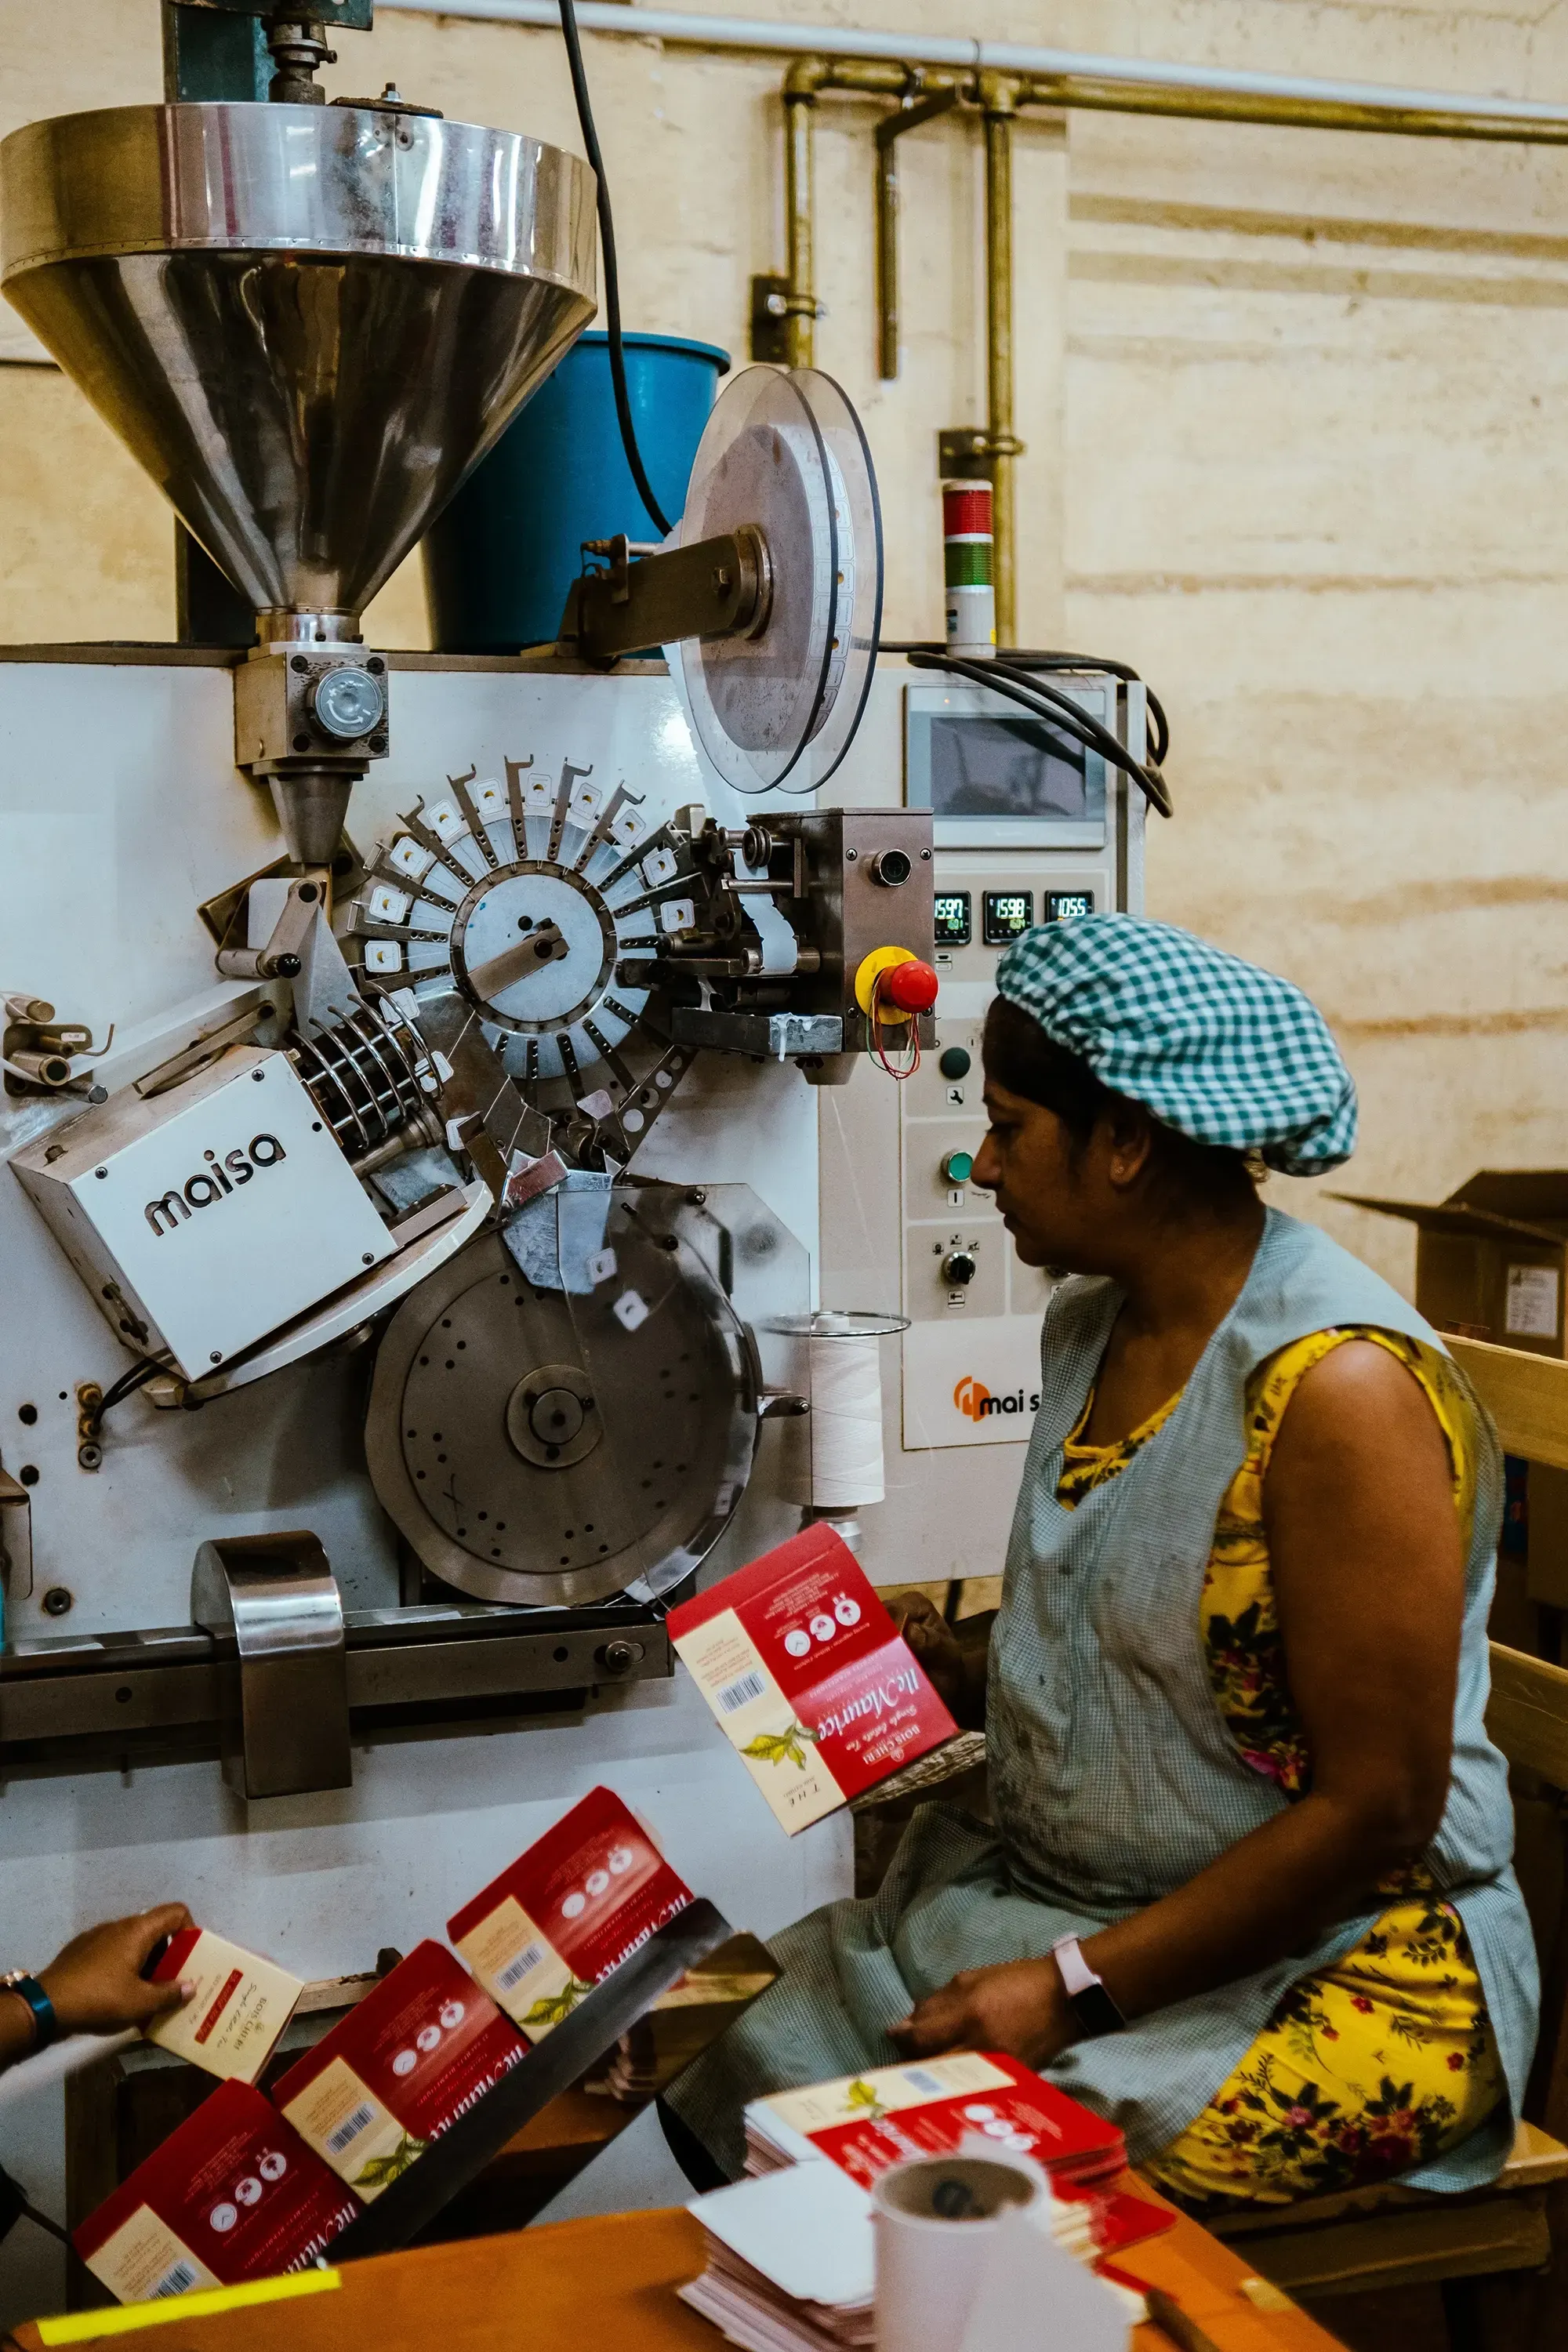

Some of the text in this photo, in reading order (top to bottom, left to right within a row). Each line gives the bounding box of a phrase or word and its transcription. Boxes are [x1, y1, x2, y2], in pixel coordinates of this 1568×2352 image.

[144, 1134, 286, 1236] maisa
[816, 1679, 897, 1740] Maurice
[862, 1722, 921, 1766] BOIS CHERI
[249, 1996, 267, 2020] BOIS
